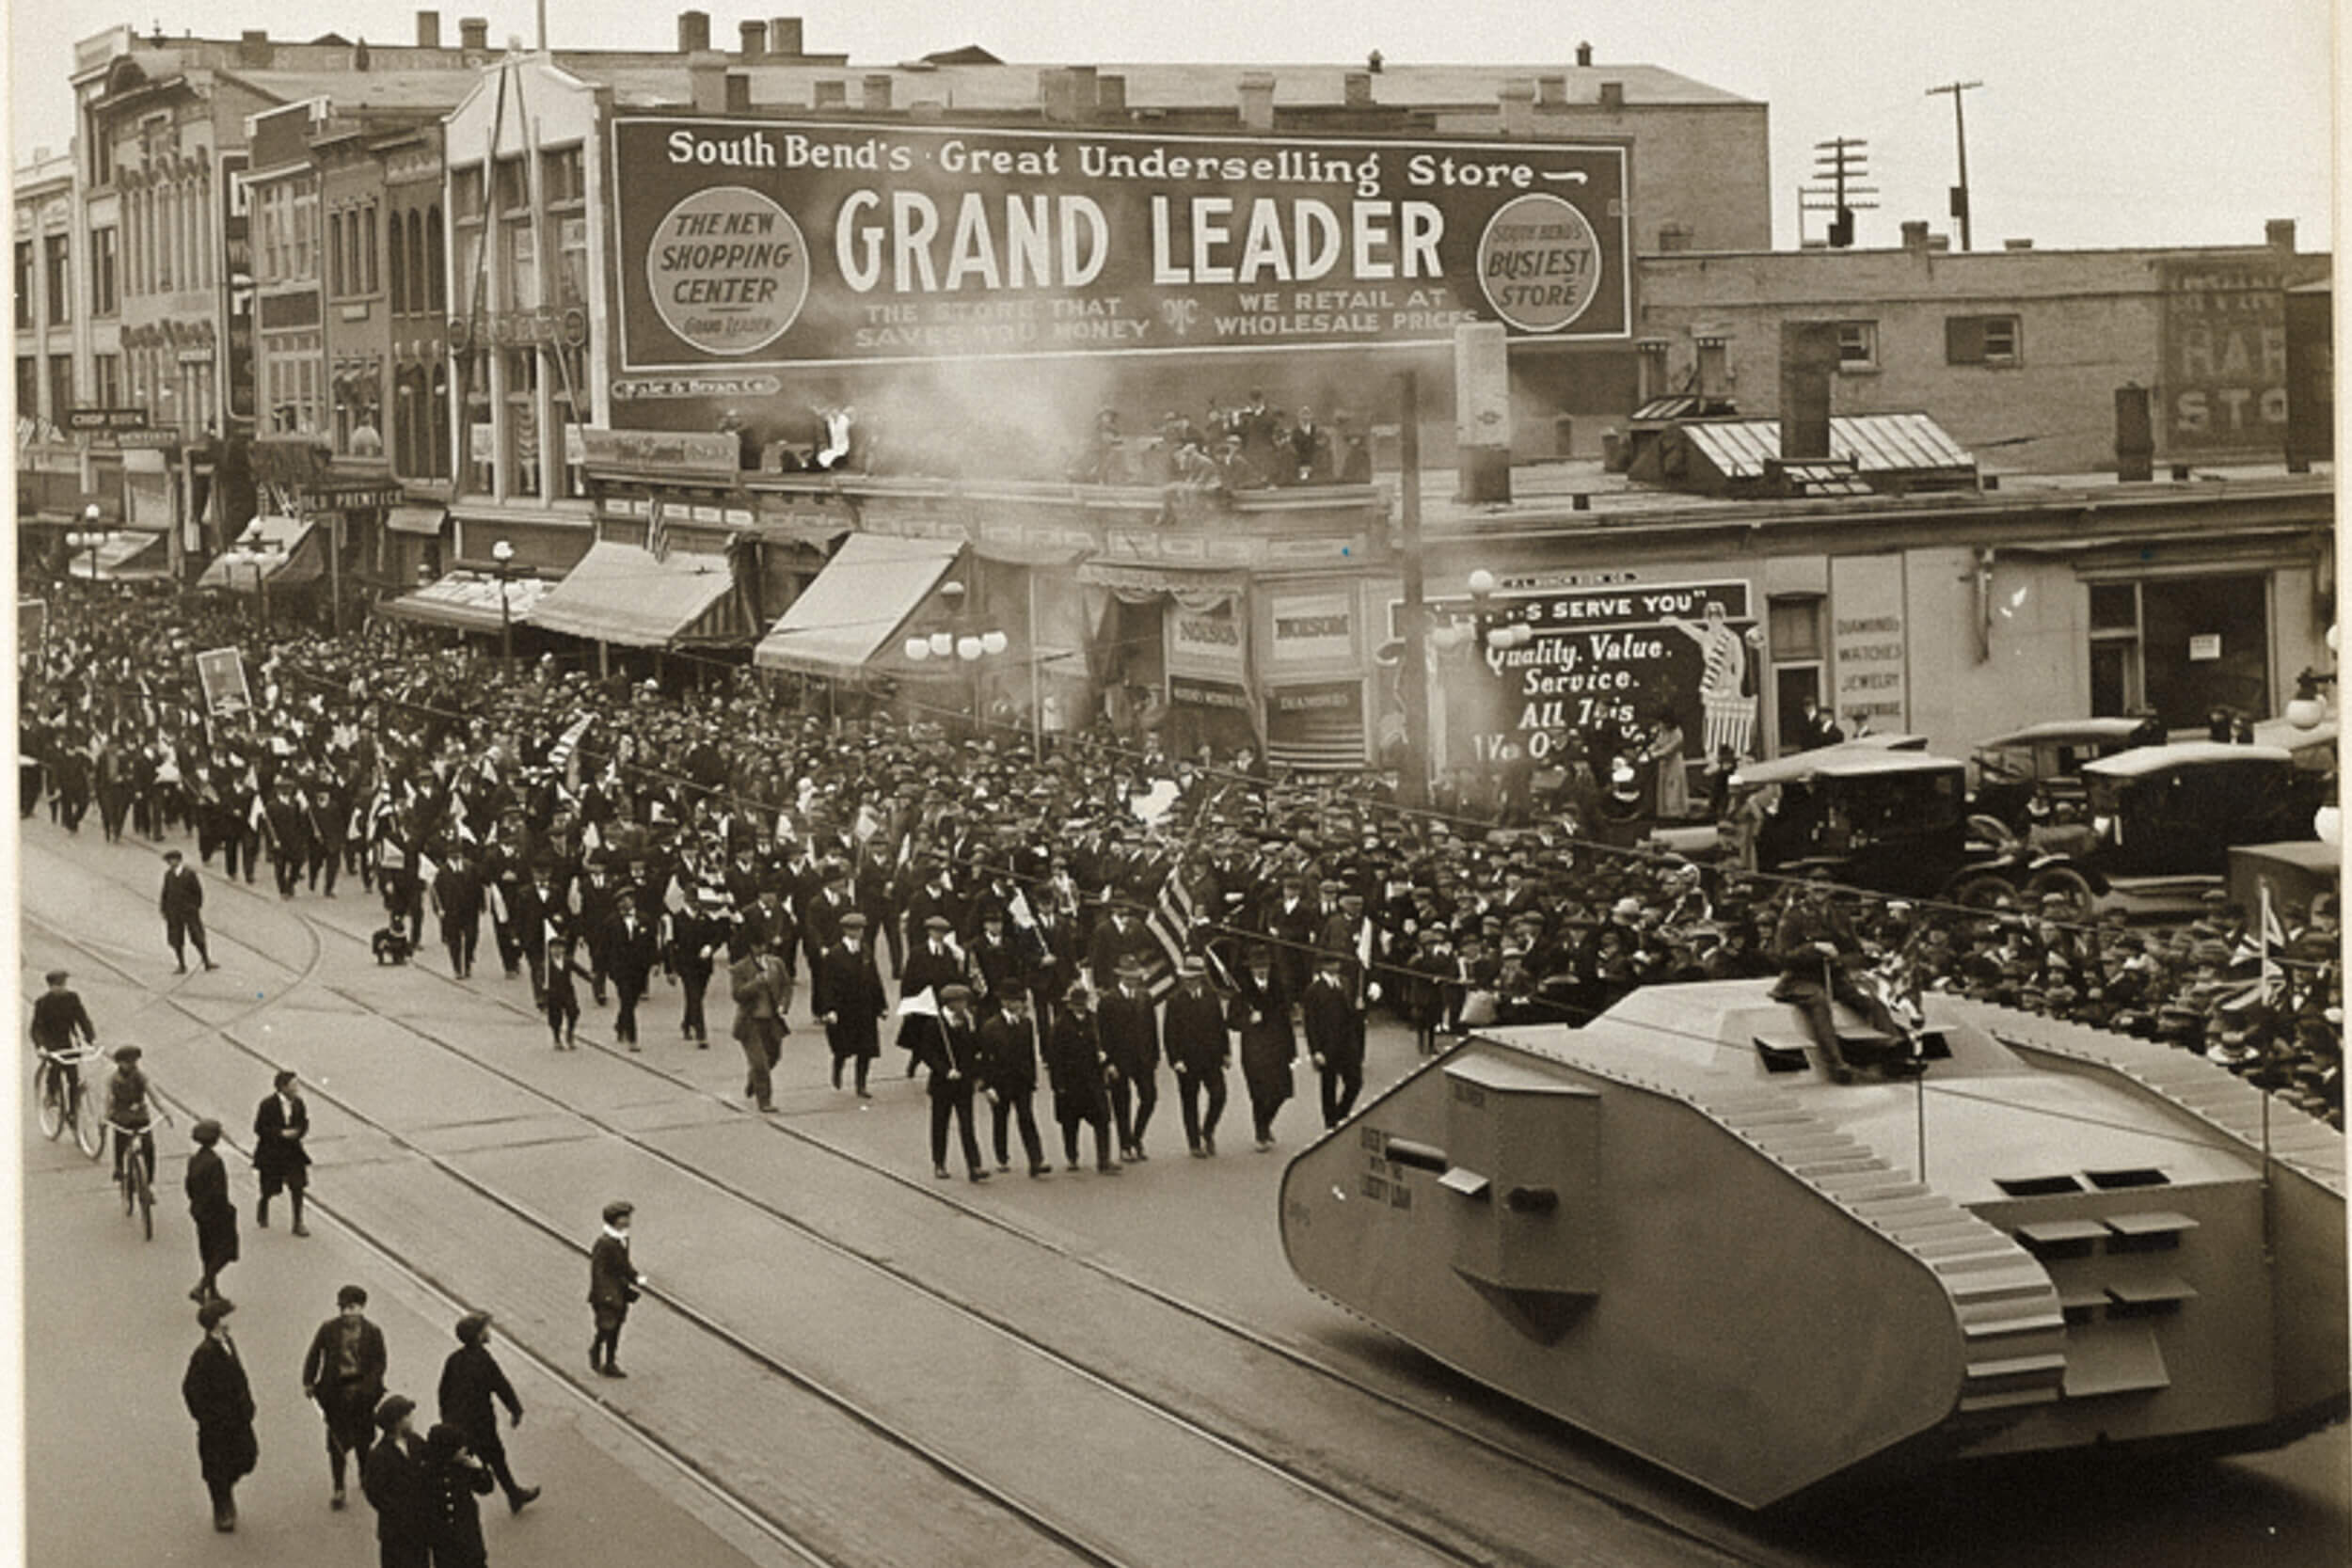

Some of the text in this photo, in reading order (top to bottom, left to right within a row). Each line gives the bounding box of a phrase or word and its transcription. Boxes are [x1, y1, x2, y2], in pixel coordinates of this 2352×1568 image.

[668, 131, 1534, 197] South Bend's Great Underselling Store
[675, 212, 777, 236] THE NEW
[835, 190, 1445, 293] GRAND LEADER
[660, 243, 793, 271] SHOPPING
[1488, 248, 1590, 279] BUSIEST
[673, 277, 779, 304] CENTER
[1239, 289, 1448, 312] WE RETAIL AT
[1501, 284, 1578, 307] STORE
[865, 304, 918, 325] THE
[1050, 296, 1123, 320] THAT
[1216, 313, 1380, 336] WHOLESALE
[855, 325, 966, 348] SAVES
[1052, 318, 1151, 340] MONEY
[1552, 599, 1632, 618] SERVE
[1590, 633, 1673, 660] Value.
[1522, 665, 1641, 695] Service.
[1518, 702, 1565, 730] All
